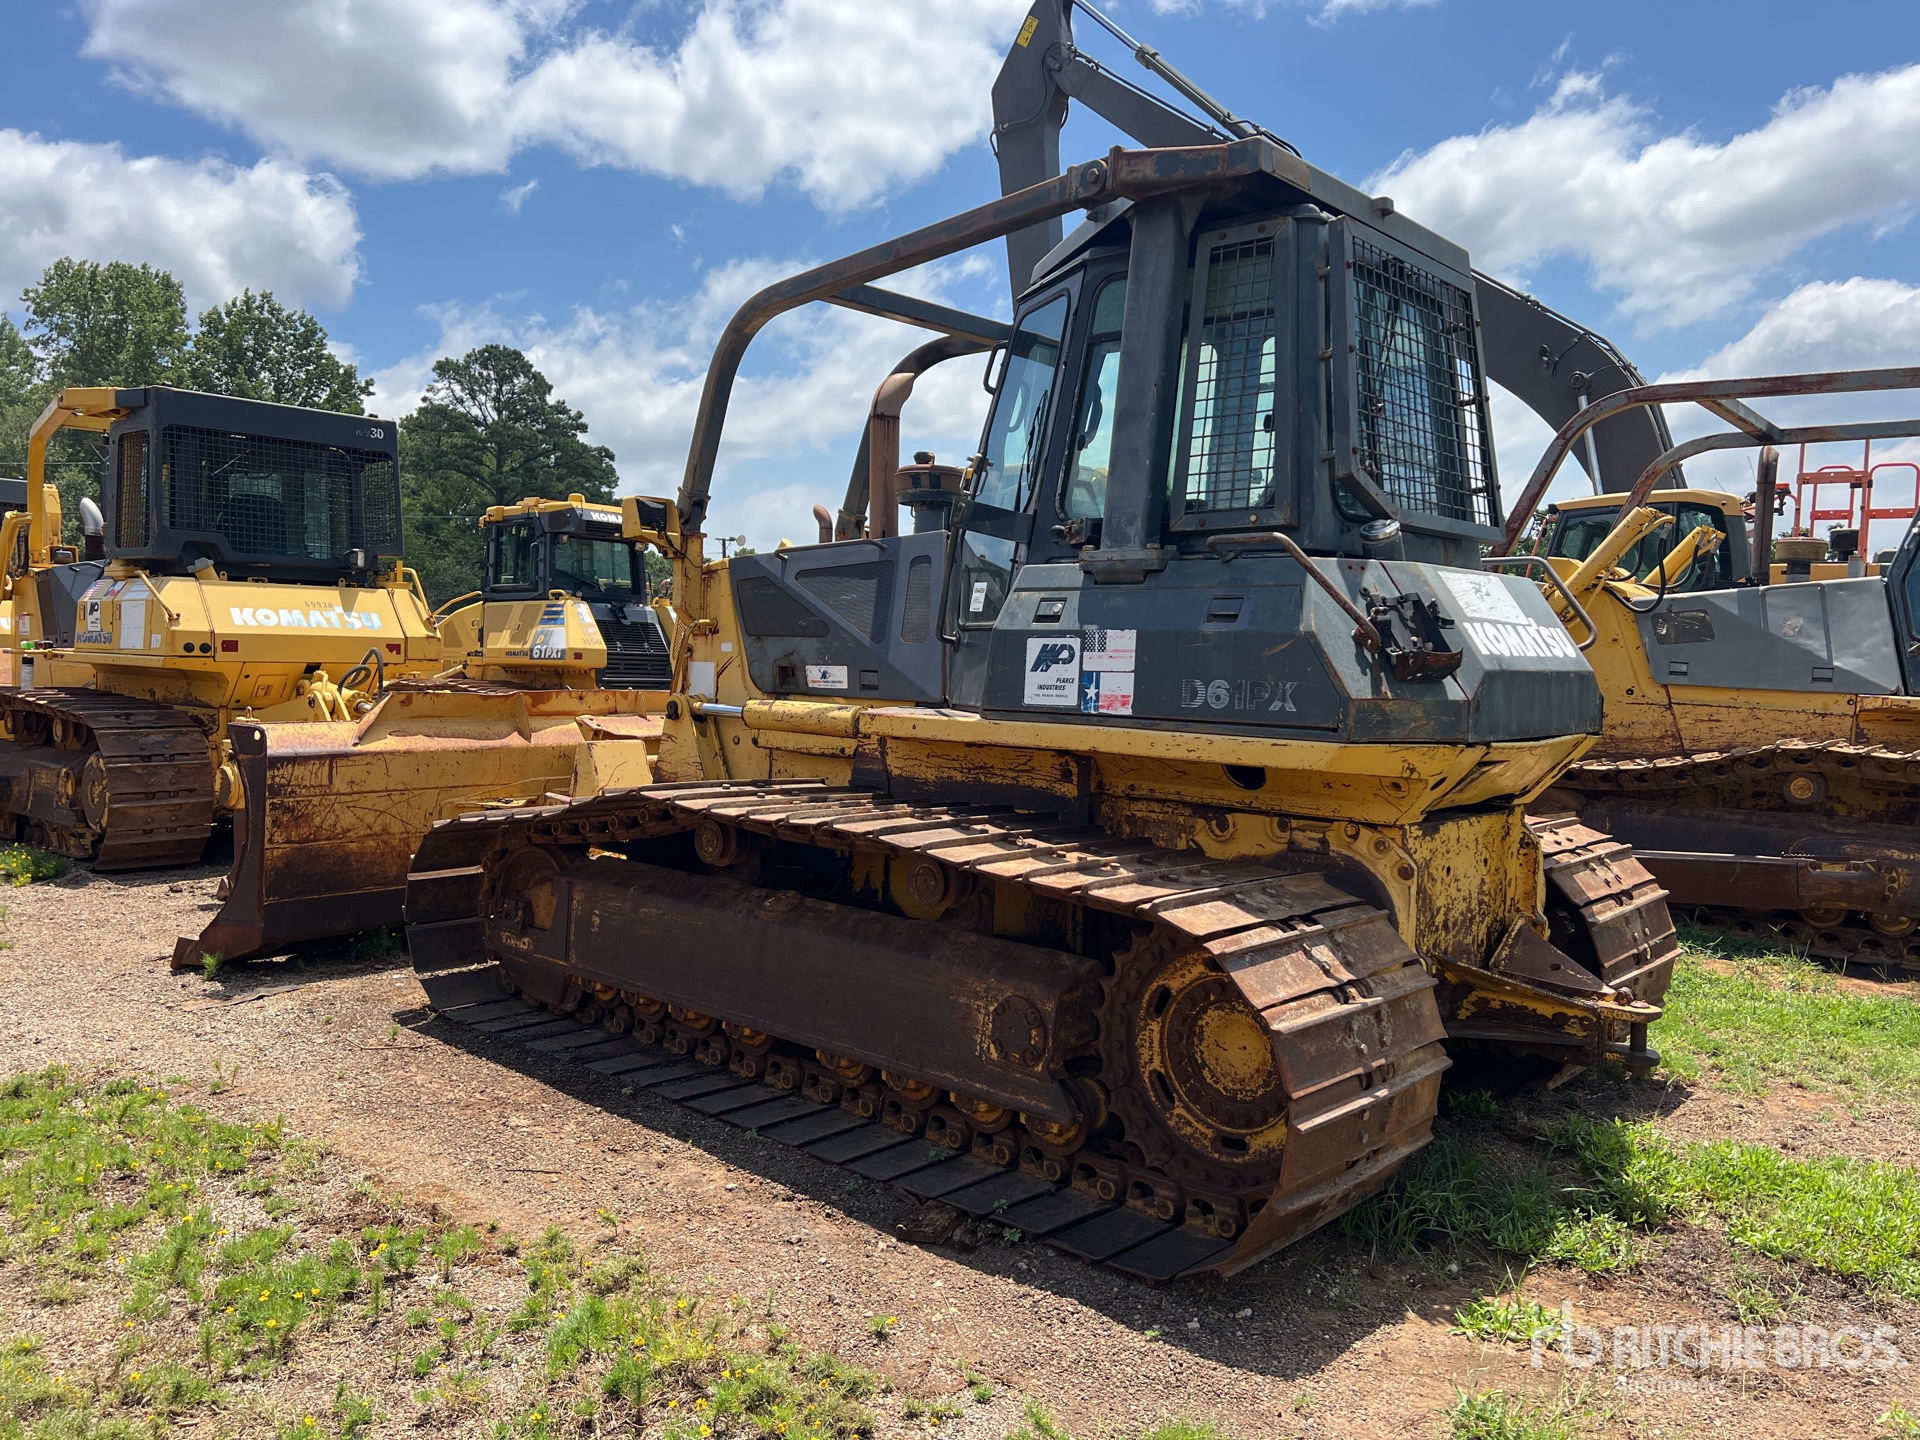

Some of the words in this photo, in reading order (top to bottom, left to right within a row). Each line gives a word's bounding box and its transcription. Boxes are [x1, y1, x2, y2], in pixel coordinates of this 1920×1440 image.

[229, 605, 382, 630] KOMATSU
[1462, 617, 1577, 658] KOMATSU
[505, 649, 529, 657] KOMATSU
[1181, 679, 1298, 712] D61PX
